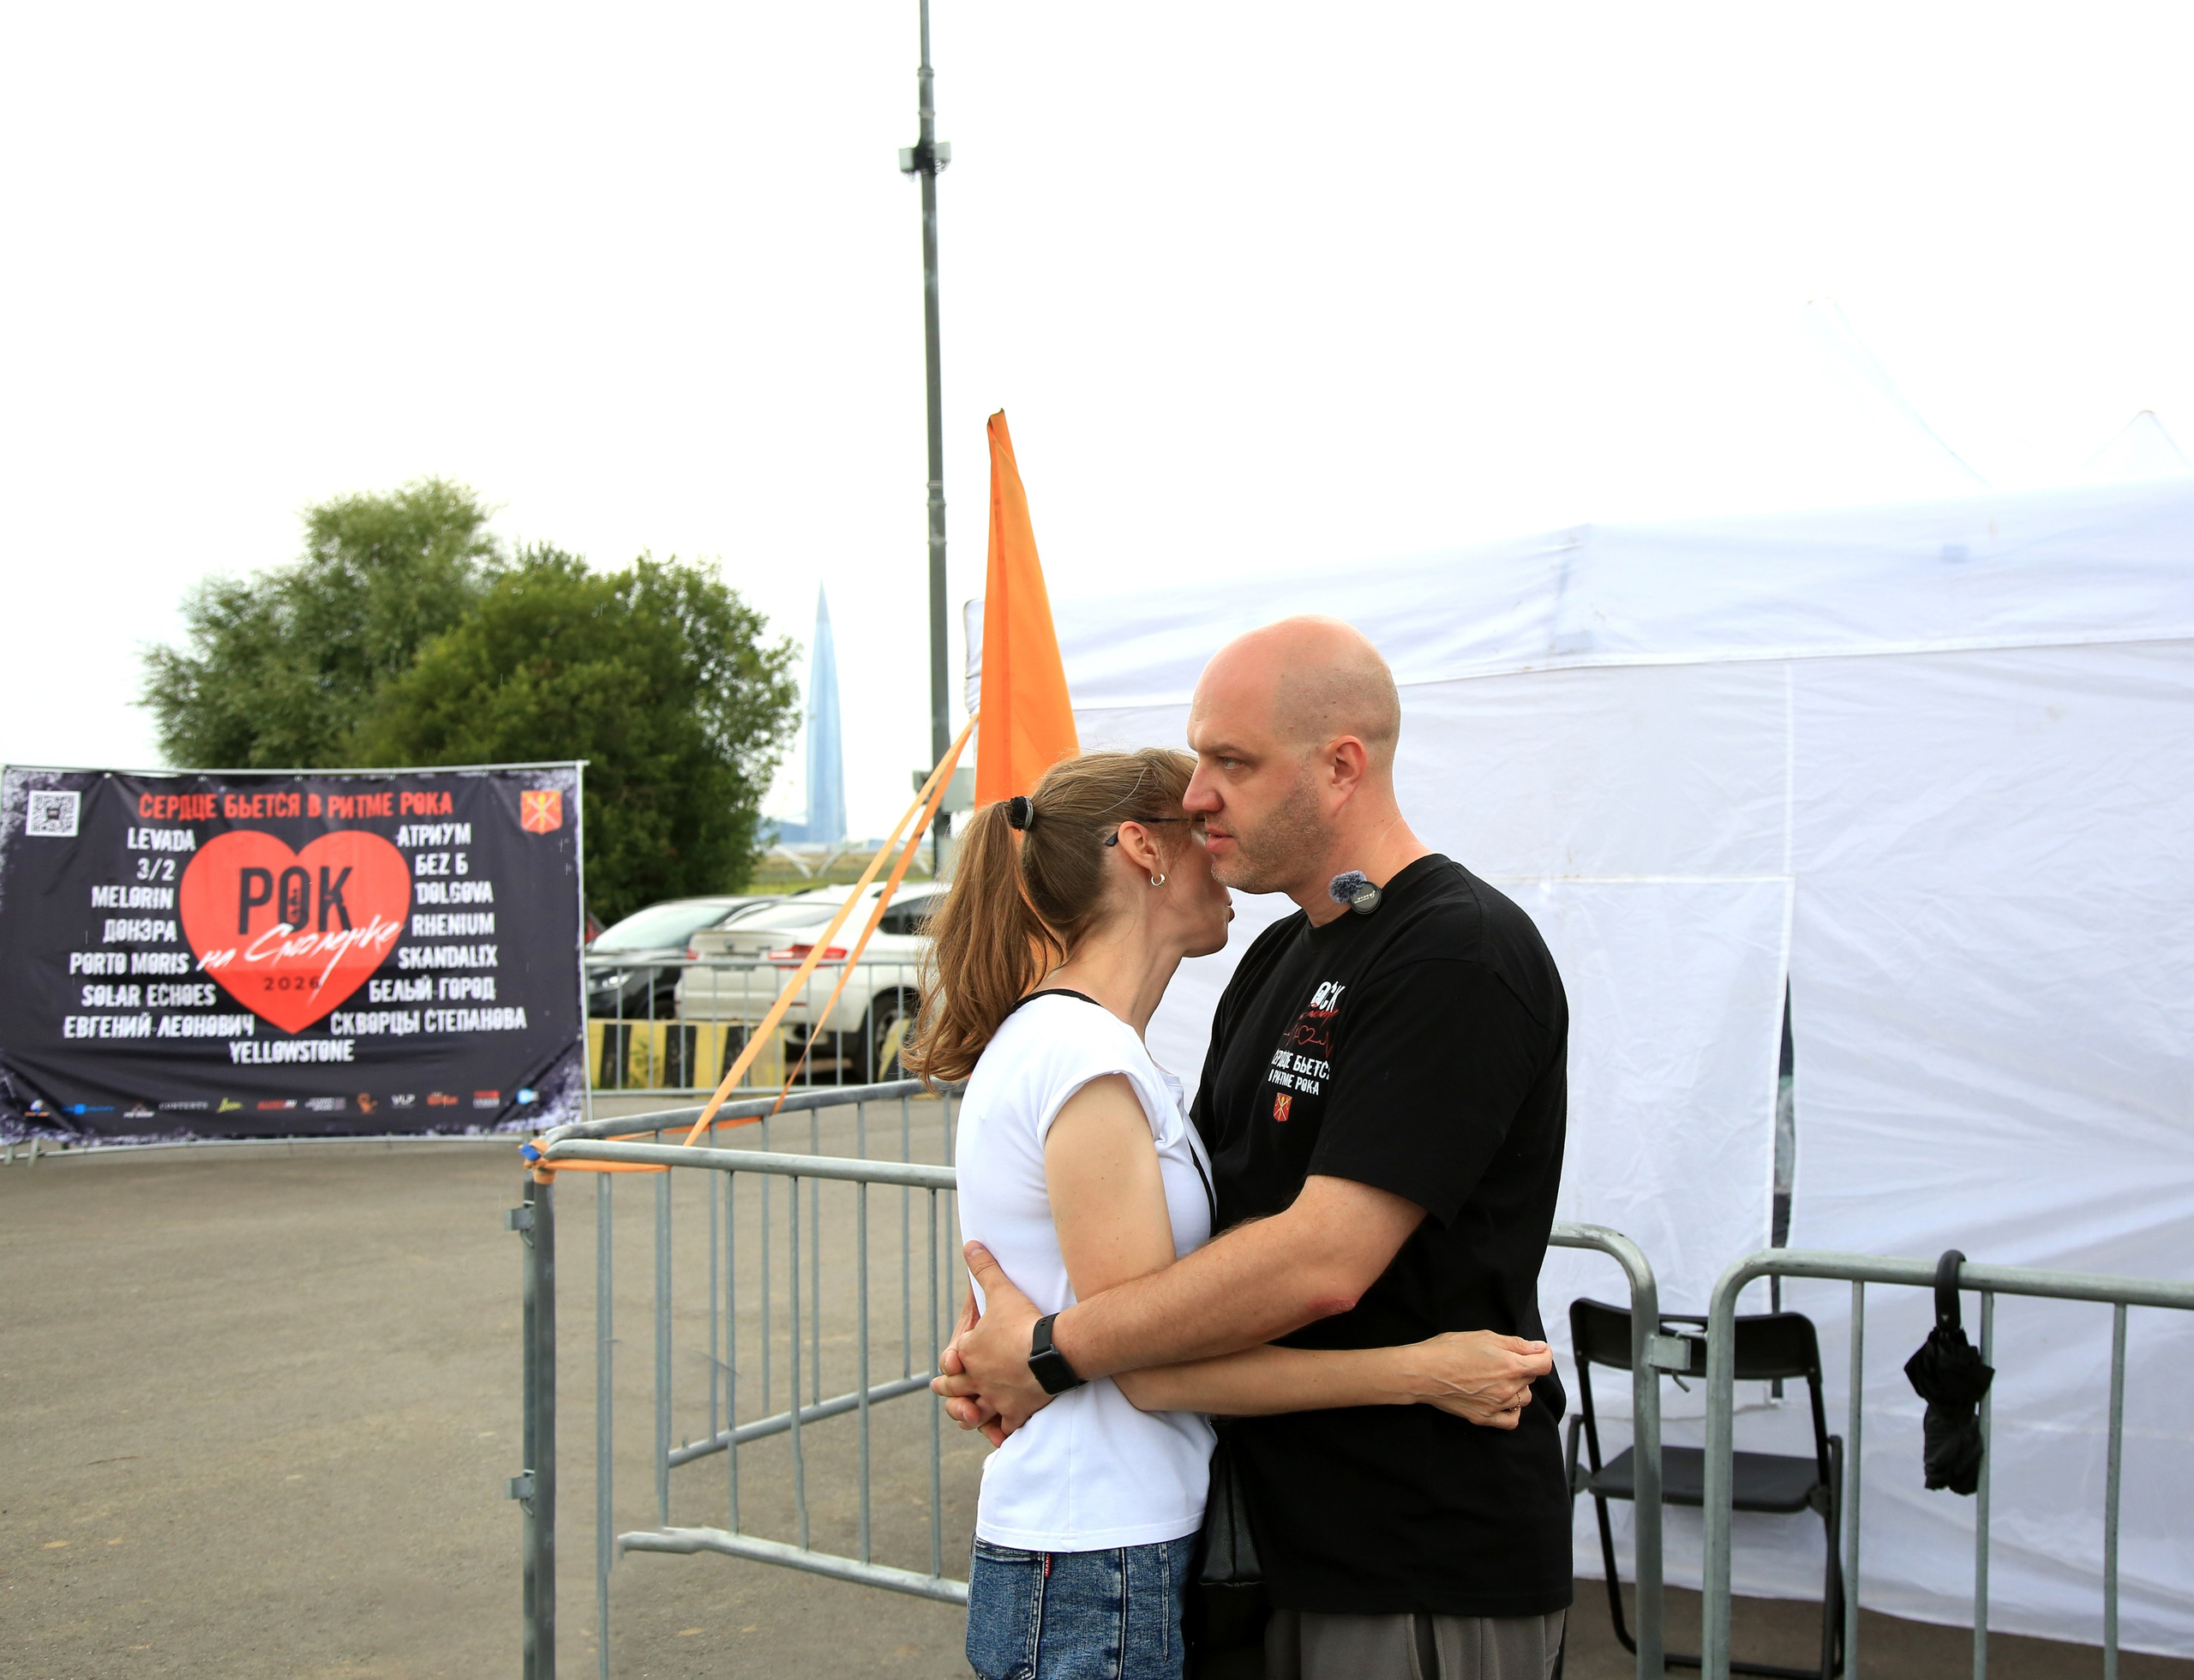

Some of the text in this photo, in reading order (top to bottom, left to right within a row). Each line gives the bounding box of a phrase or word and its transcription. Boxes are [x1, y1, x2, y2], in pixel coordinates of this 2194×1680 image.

[139, 791, 453, 822] СЕРДЦЕ БЬЕТСЯ В РИТМЕ РОКА
[127, 827, 196, 851] LEVADA
[396, 823, 471, 847] АТРИУМ
[136, 857, 176, 881] 3/2
[455, 853, 469, 875] Б
[91, 885, 175, 909] MELORIN
[238, 866, 352, 934] РОК
[416, 880, 494, 904] DOLGOVA
[103, 918, 177, 943] ДОНЭРА
[412, 912, 495, 937] RHENIUM
[69, 952, 190, 975] PORTO MORIS
[196, 948, 237, 971] на
[398, 944, 498, 969] SKANDALIX
[81, 983, 217, 1007] SOLAR ECHOES
[263, 975, 321, 991] 2026
[369, 975, 496, 1003] БЕЛЫЙ ГОРОД
[63, 1012, 255, 1038] ЕВГЕНИЙ ЛЕОНОВИЧ
[330, 1006, 527, 1035] СКВОРЦЫ СТЕПАНОВА
[229, 1039, 356, 1064] YELLOWSTONE
[1295, 1077, 1320, 1095] РОКА
